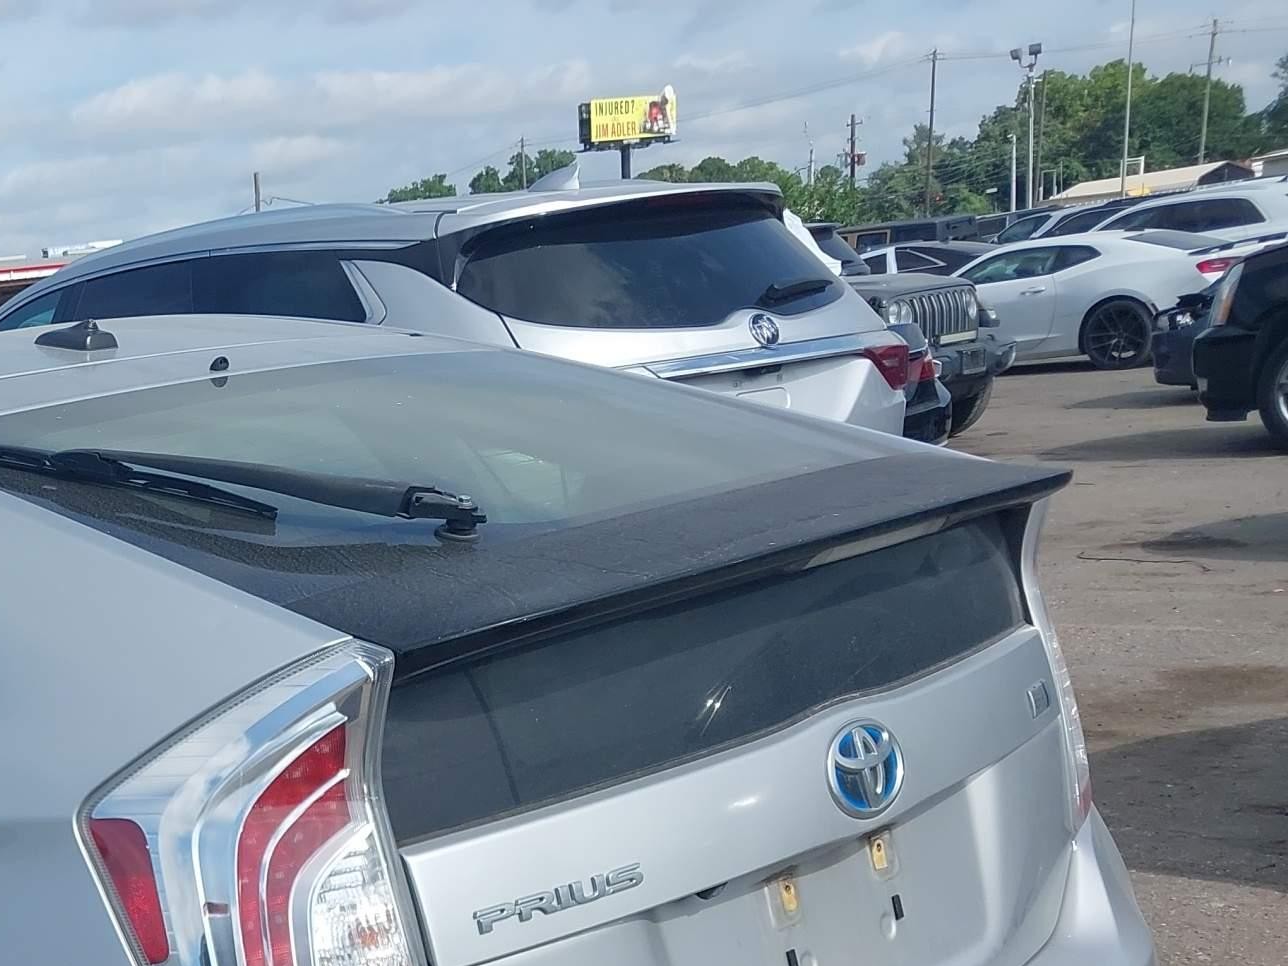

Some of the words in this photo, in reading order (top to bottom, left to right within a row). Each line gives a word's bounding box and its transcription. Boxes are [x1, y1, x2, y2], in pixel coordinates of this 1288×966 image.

[595, 100, 635, 116] INJURED?
[595, 123, 609, 139] JIM
[611, 121, 637, 138] ADLER
[472, 862, 644, 936] PRIUS
